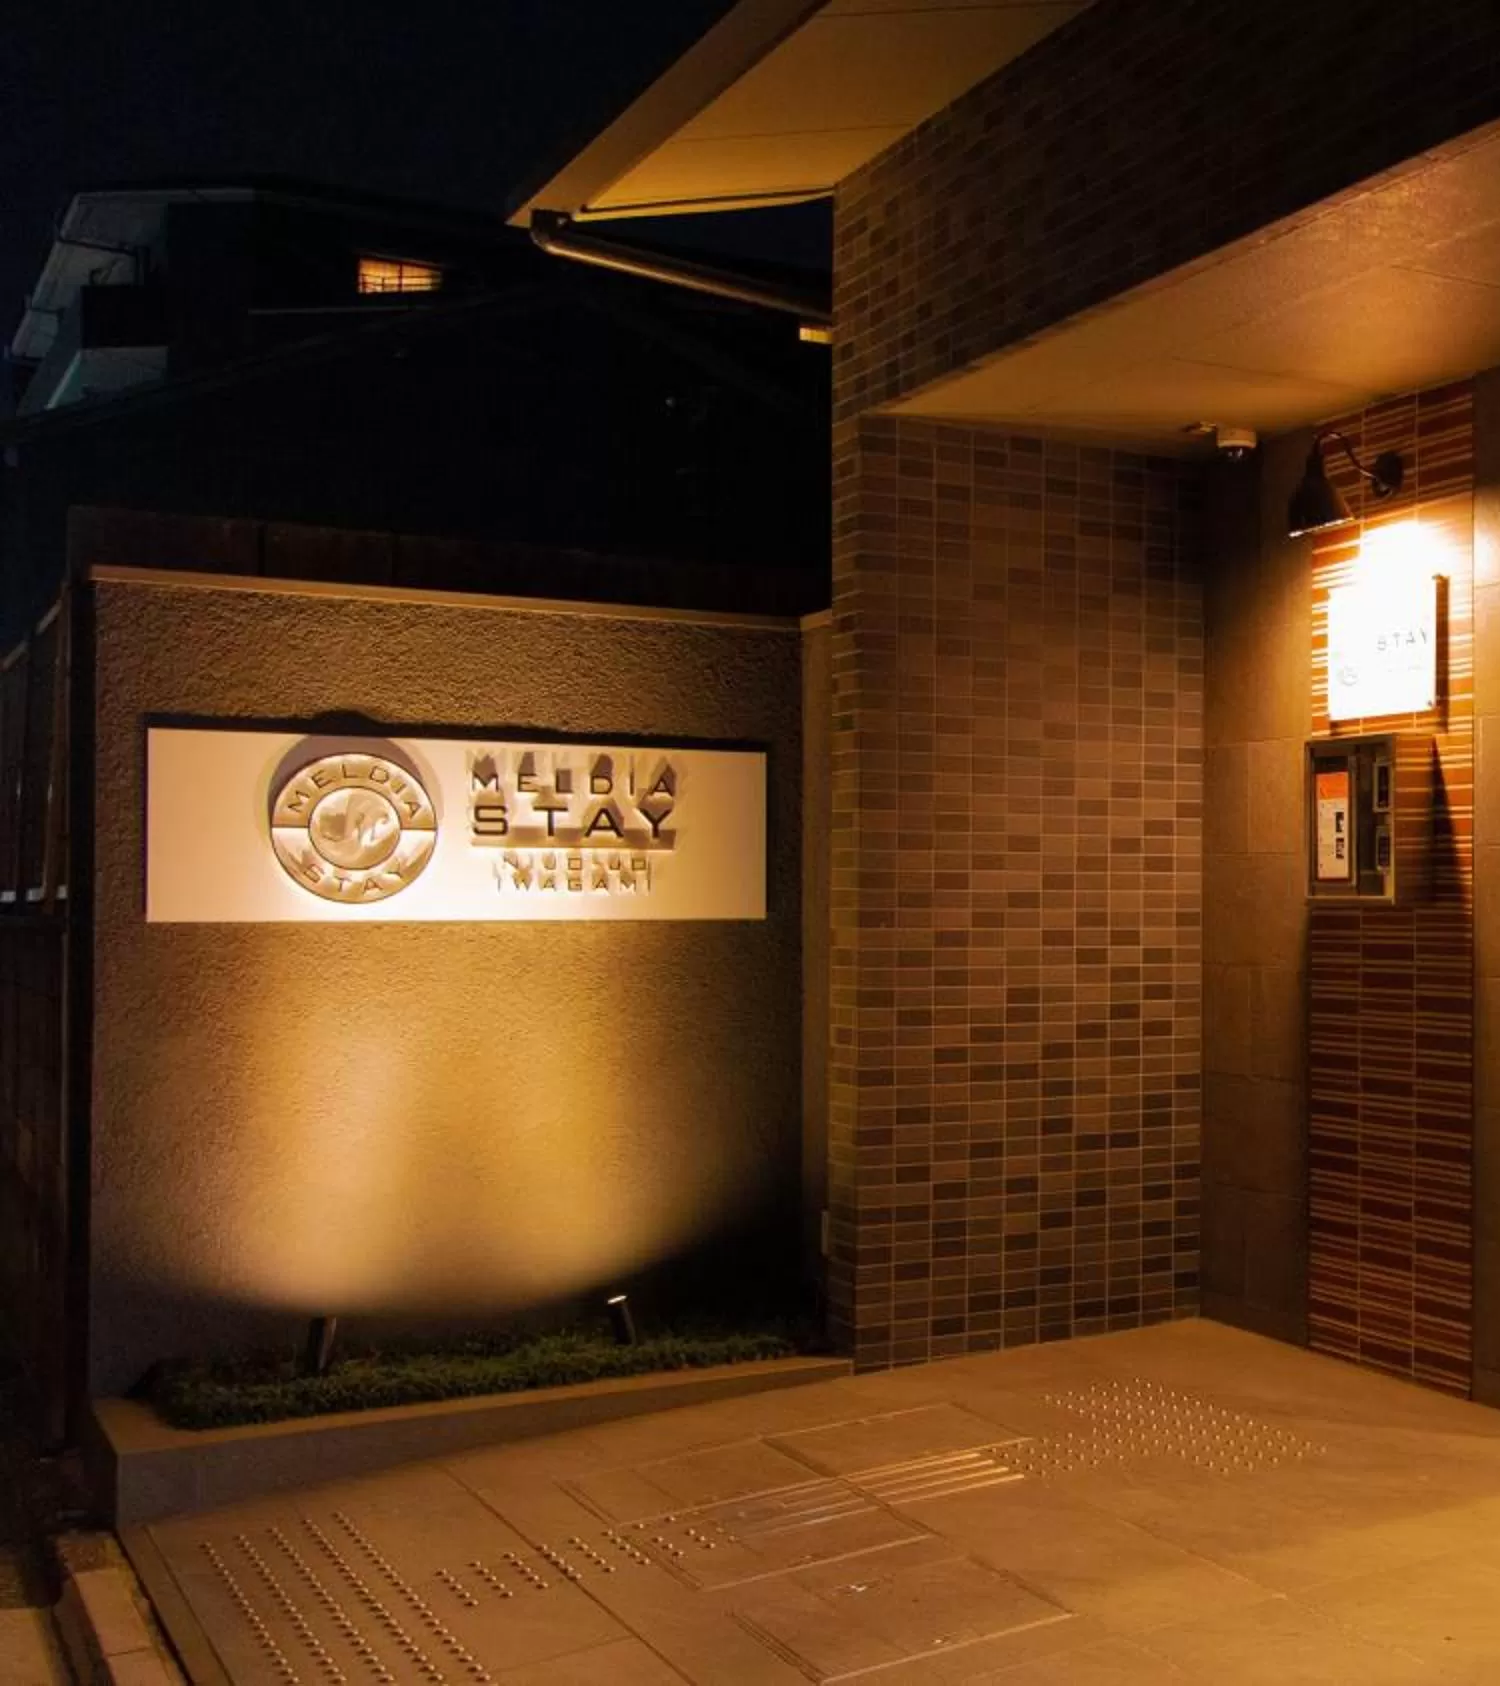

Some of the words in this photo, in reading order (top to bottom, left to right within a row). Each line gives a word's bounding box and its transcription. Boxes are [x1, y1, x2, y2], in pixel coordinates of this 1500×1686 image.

[288, 763, 422, 819] MELDIA
[472, 772, 676, 797] MELDIA
[474, 805, 673, 838] STAY
[302, 861, 405, 894] STAY
